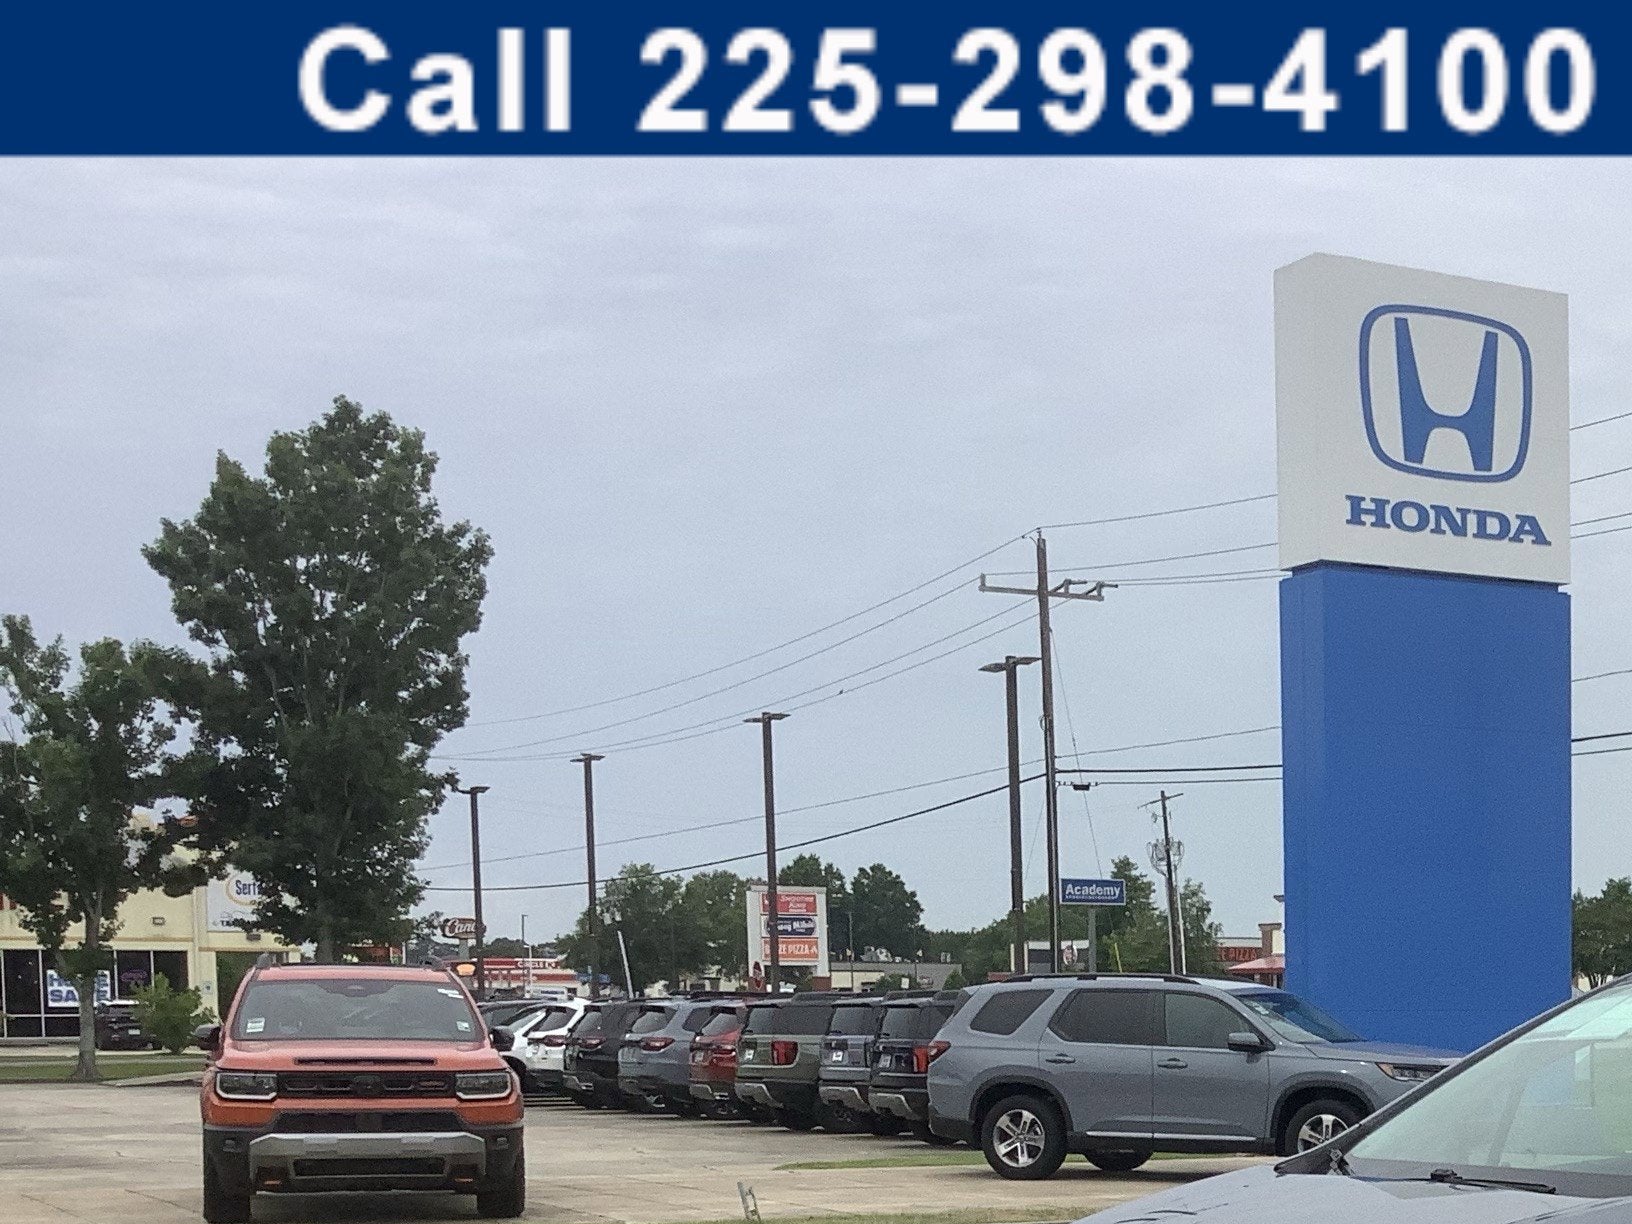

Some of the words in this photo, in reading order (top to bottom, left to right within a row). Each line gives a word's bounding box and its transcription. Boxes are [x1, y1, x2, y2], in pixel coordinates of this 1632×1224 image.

[1345, 494, 1552, 547] HONDA
[1065, 883, 1121, 899] Academy
[788, 944, 810, 955] PIZZA
